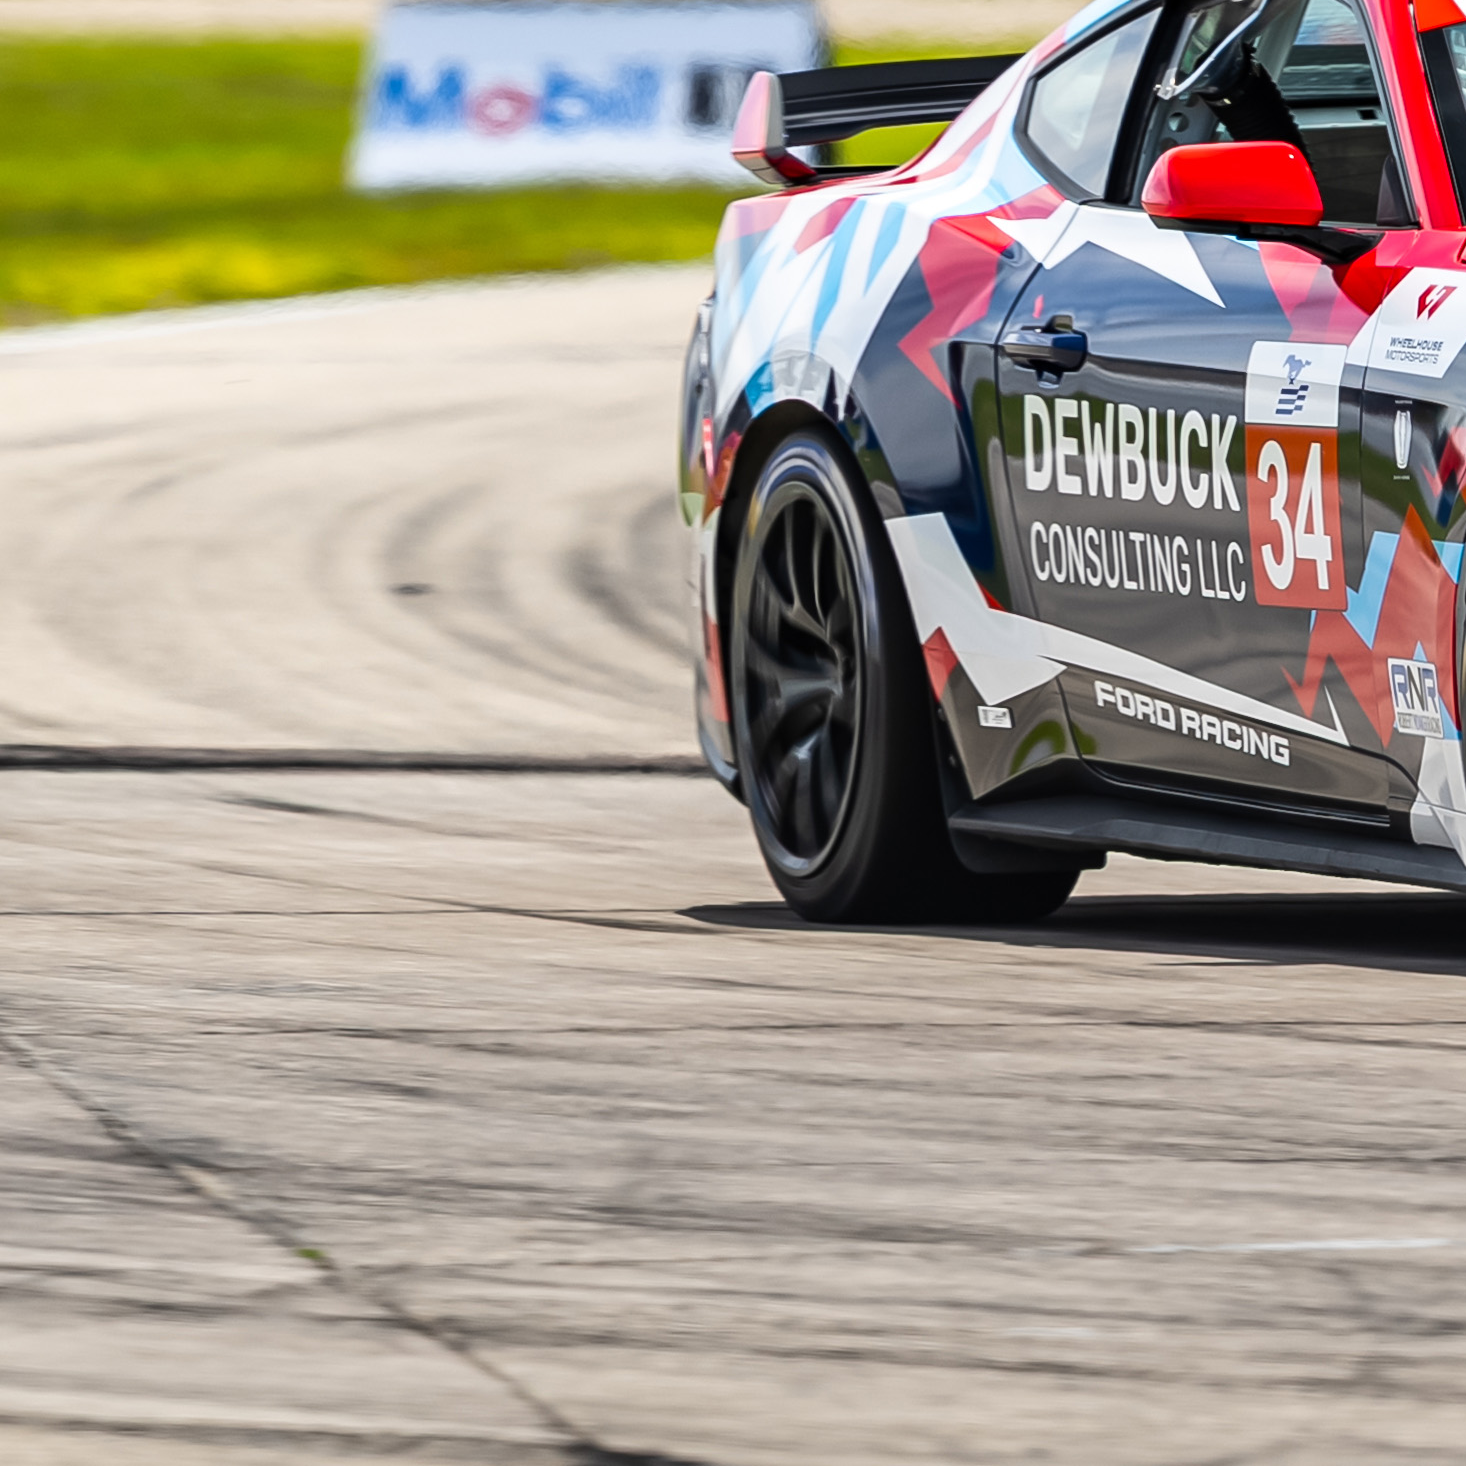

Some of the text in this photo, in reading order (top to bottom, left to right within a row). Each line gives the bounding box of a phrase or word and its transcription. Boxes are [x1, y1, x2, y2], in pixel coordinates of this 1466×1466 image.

[376, 58, 662, 138] Mobil
[1385, 349, 1439, 364] MOTORSPORTS
[1390, 337, 1443, 351] WHEELHOUSE
[1023, 394, 1241, 512] DEWBUCK
[1257, 439, 1333, 591] 34
[1030, 521, 1246, 602] CONSULTING LLC
[1094, 680, 1291, 767] FORD RACING
[1391, 664, 1438, 714] RNR
